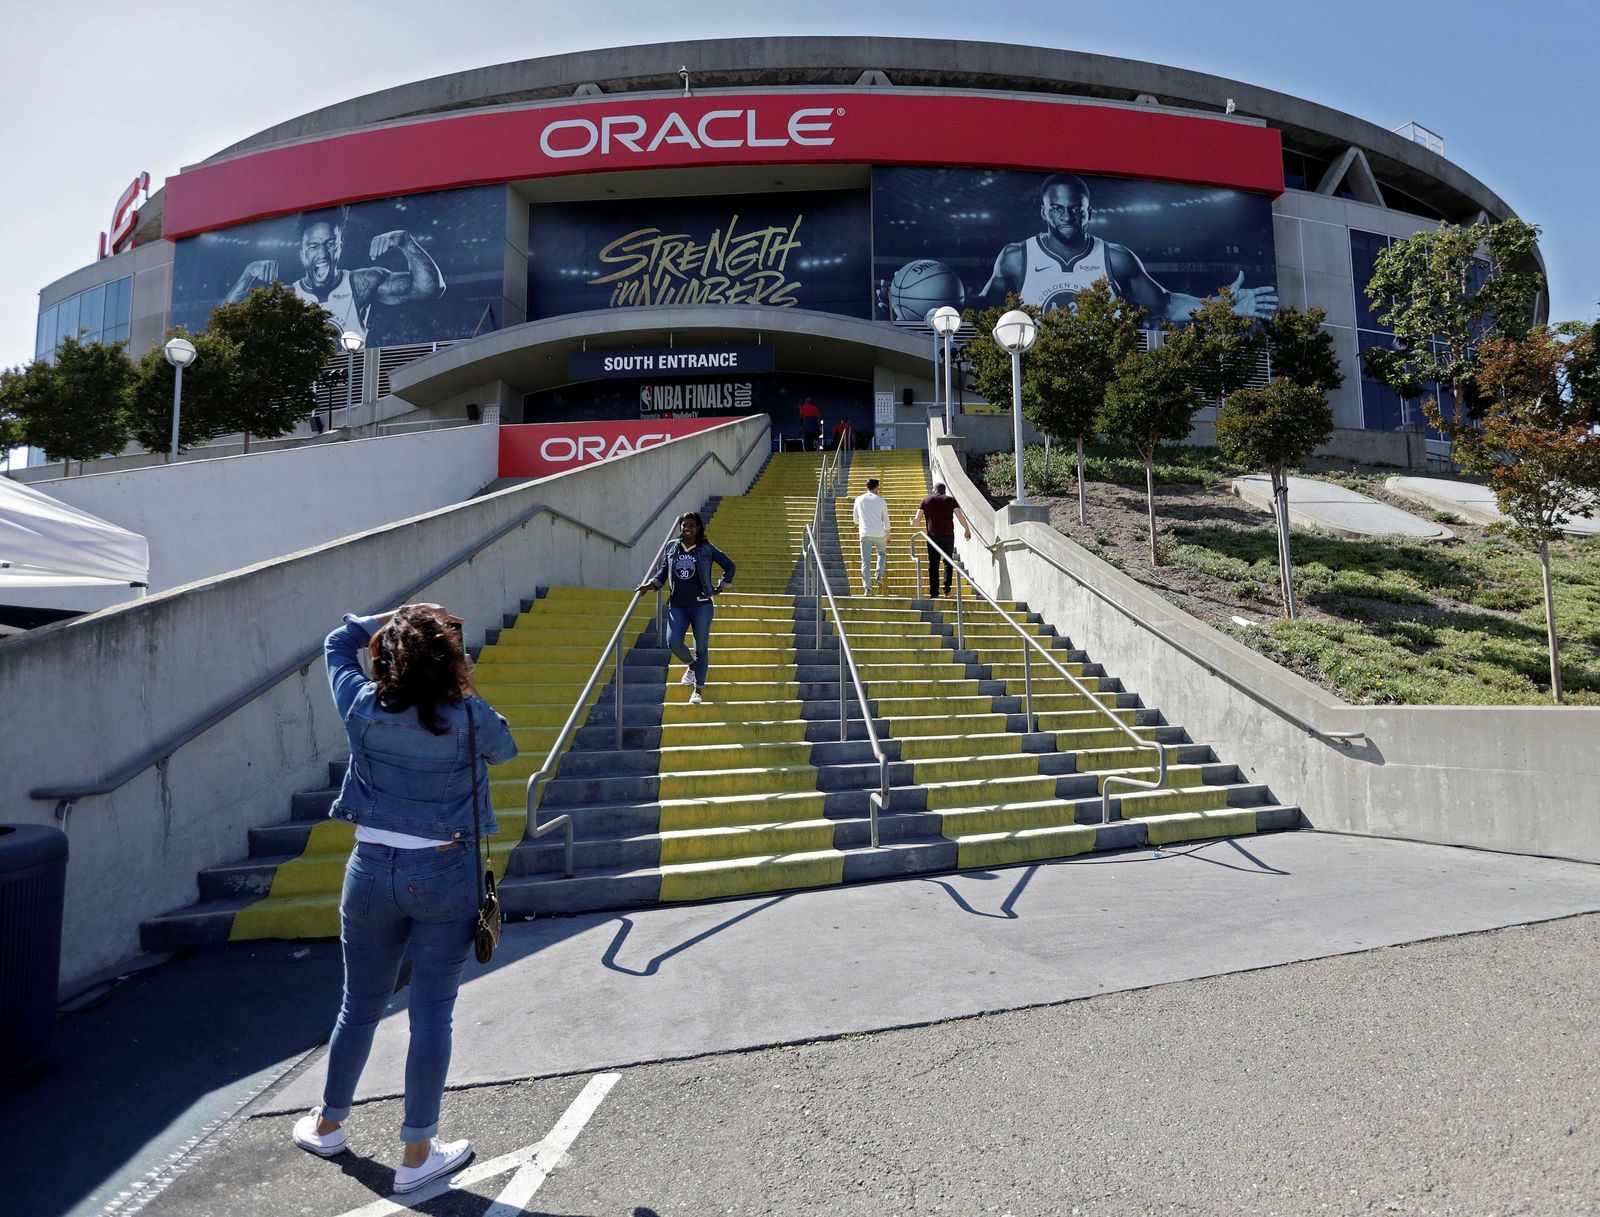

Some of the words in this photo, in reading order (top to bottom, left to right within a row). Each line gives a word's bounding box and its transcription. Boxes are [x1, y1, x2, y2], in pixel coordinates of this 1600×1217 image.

[539, 107, 836, 158] ORACLE
[585, 213, 803, 288] STRENGTH
[1038, 282, 1071, 302] GOLDEN
[603, 355, 654, 371] SOUTH
[658, 352, 738, 369] ENTRANCE
[653, 385, 683, 410] NBA
[685, 383, 733, 409] FINALS
[734, 382, 752, 408] 2019
[680, 569, 689, 578] 30
